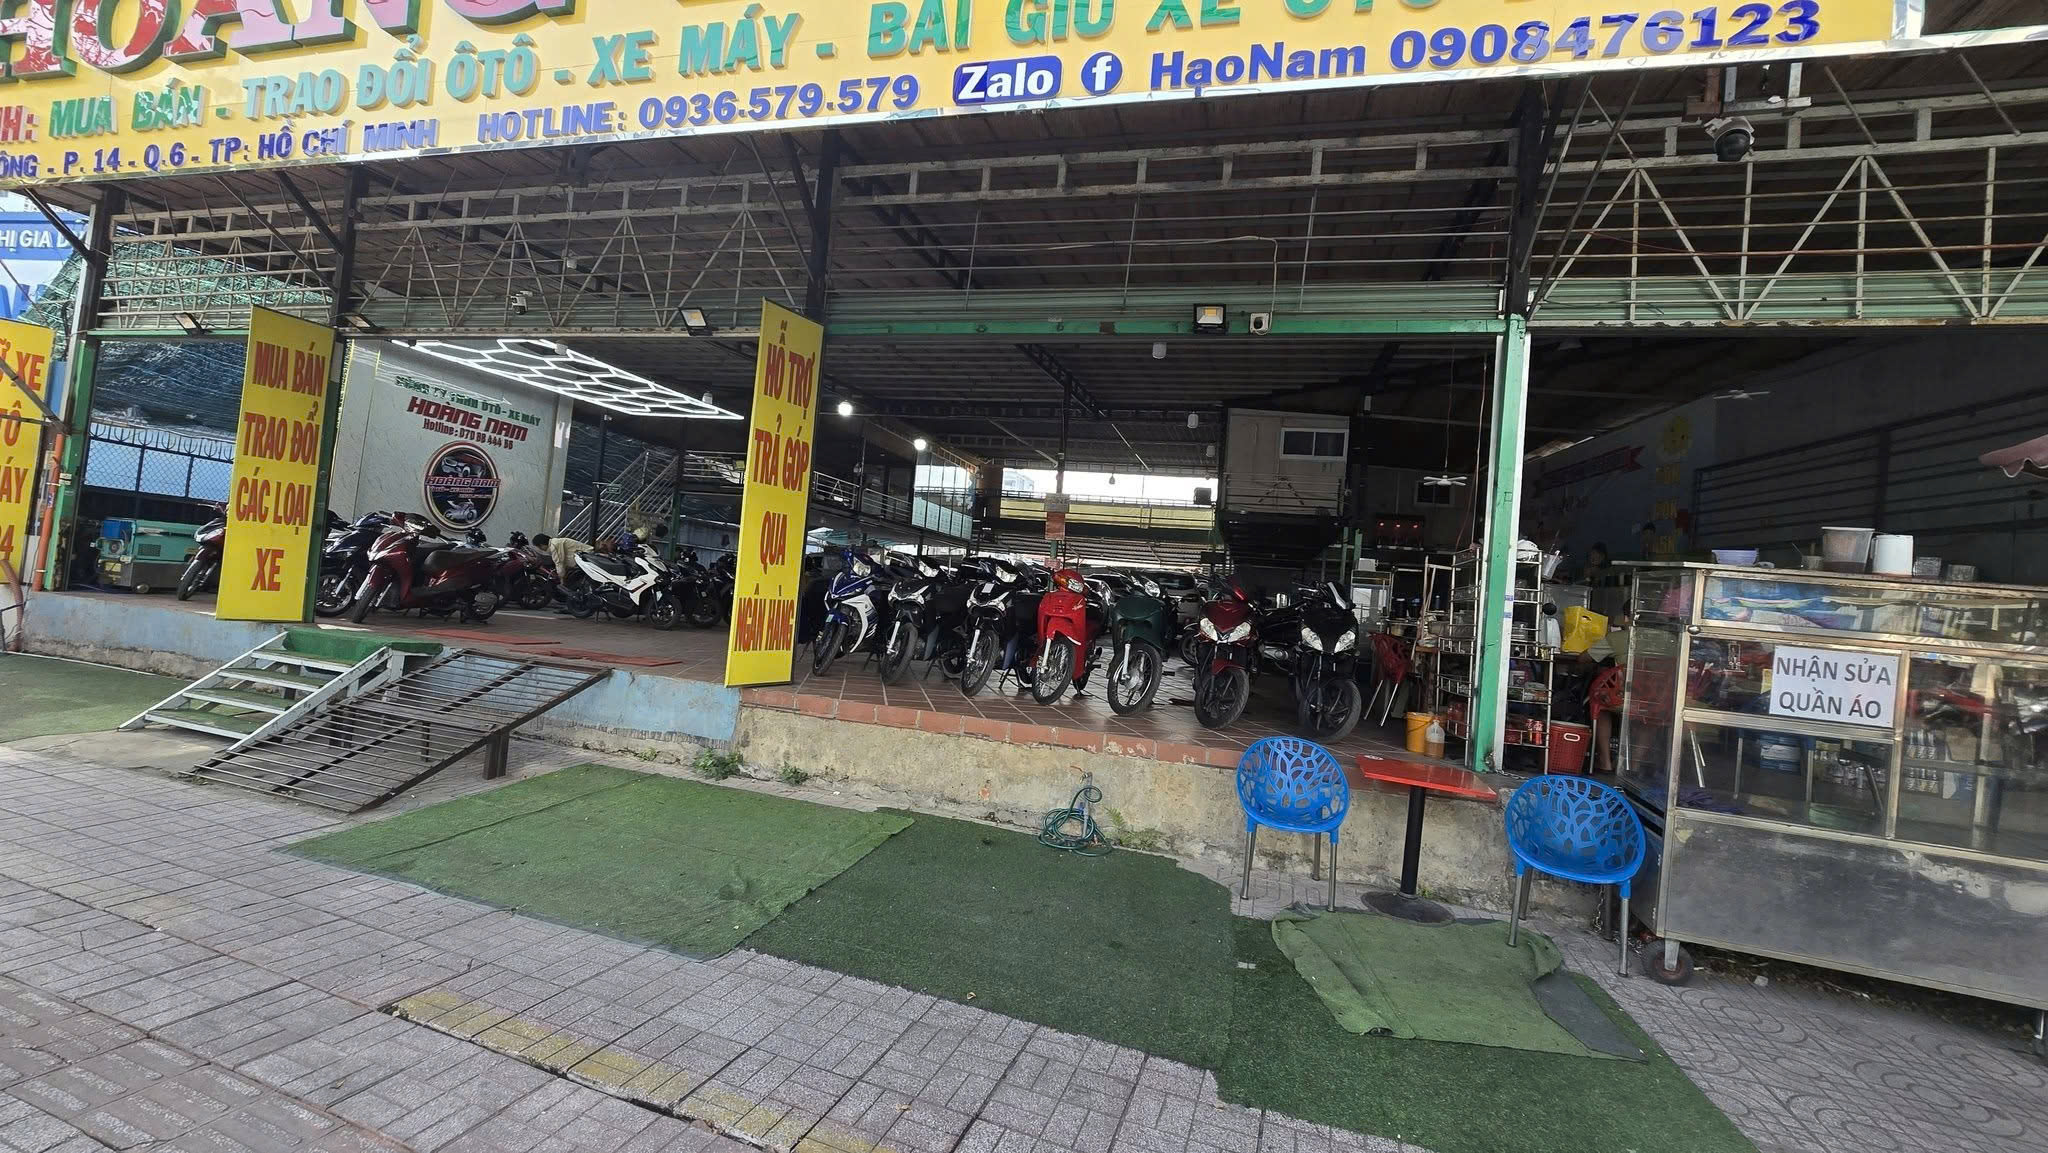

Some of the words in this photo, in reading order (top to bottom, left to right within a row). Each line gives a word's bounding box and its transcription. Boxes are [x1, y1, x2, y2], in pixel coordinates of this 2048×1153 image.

[50, 97, 116, 137] MUA
[132, 78, 205, 131] BÁN
[242, 69, 343, 120] TRAO
[356, 34, 435, 110] ĐỔI
[445, 33, 538, 101] ÔTÔ
[587, 30, 656, 86] XE
[678, 3, 800, 76] MÁY
[209, 137, 250, 163] TP:
[258, 119, 296, 160] HỒ
[302, 119, 355, 156] CHÍ
[363, 119, 440, 152] MINH
[477, 101, 627, 143] HOTLINE:
[638, 74, 919, 130] 0936.579.579
[957, 62, 1055, 99] Zalo
[1150, 41, 1366, 91] HaoNam
[1389, 0, 1821, 70] 0908476123
[19, 229, 53, 248] GIA
[14, 350, 45, 391] XE
[252, 341, 289, 391] MUA
[291, 341, 326, 398] BÁN
[787, 351, 815, 420] TRỢ
[243, 411, 287, 461] TRAO
[290, 401, 321, 467] ĐỔI
[407, 396, 482, 430] HOÀNG
[484, 417, 528, 442] NAM
[508, 409, 520, 421] XE
[753, 413, 782, 487] TRẢ
[782, 425, 810, 492] GÓP
[235, 466, 270, 524] CÁC
[273, 480, 312, 536] LOẠI
[251, 548, 285, 592] XE
[760, 510, 788, 576] QUA
[734, 583, 767, 653] NGÂN
[765, 584, 795, 652] HÀNG
[1776, 655, 1838, 682] NHẬN
[1844, 657, 1891, 686] SỬA
[1779, 686, 1842, 714] QUẦN
[1848, 694, 1881, 719] ÁO
